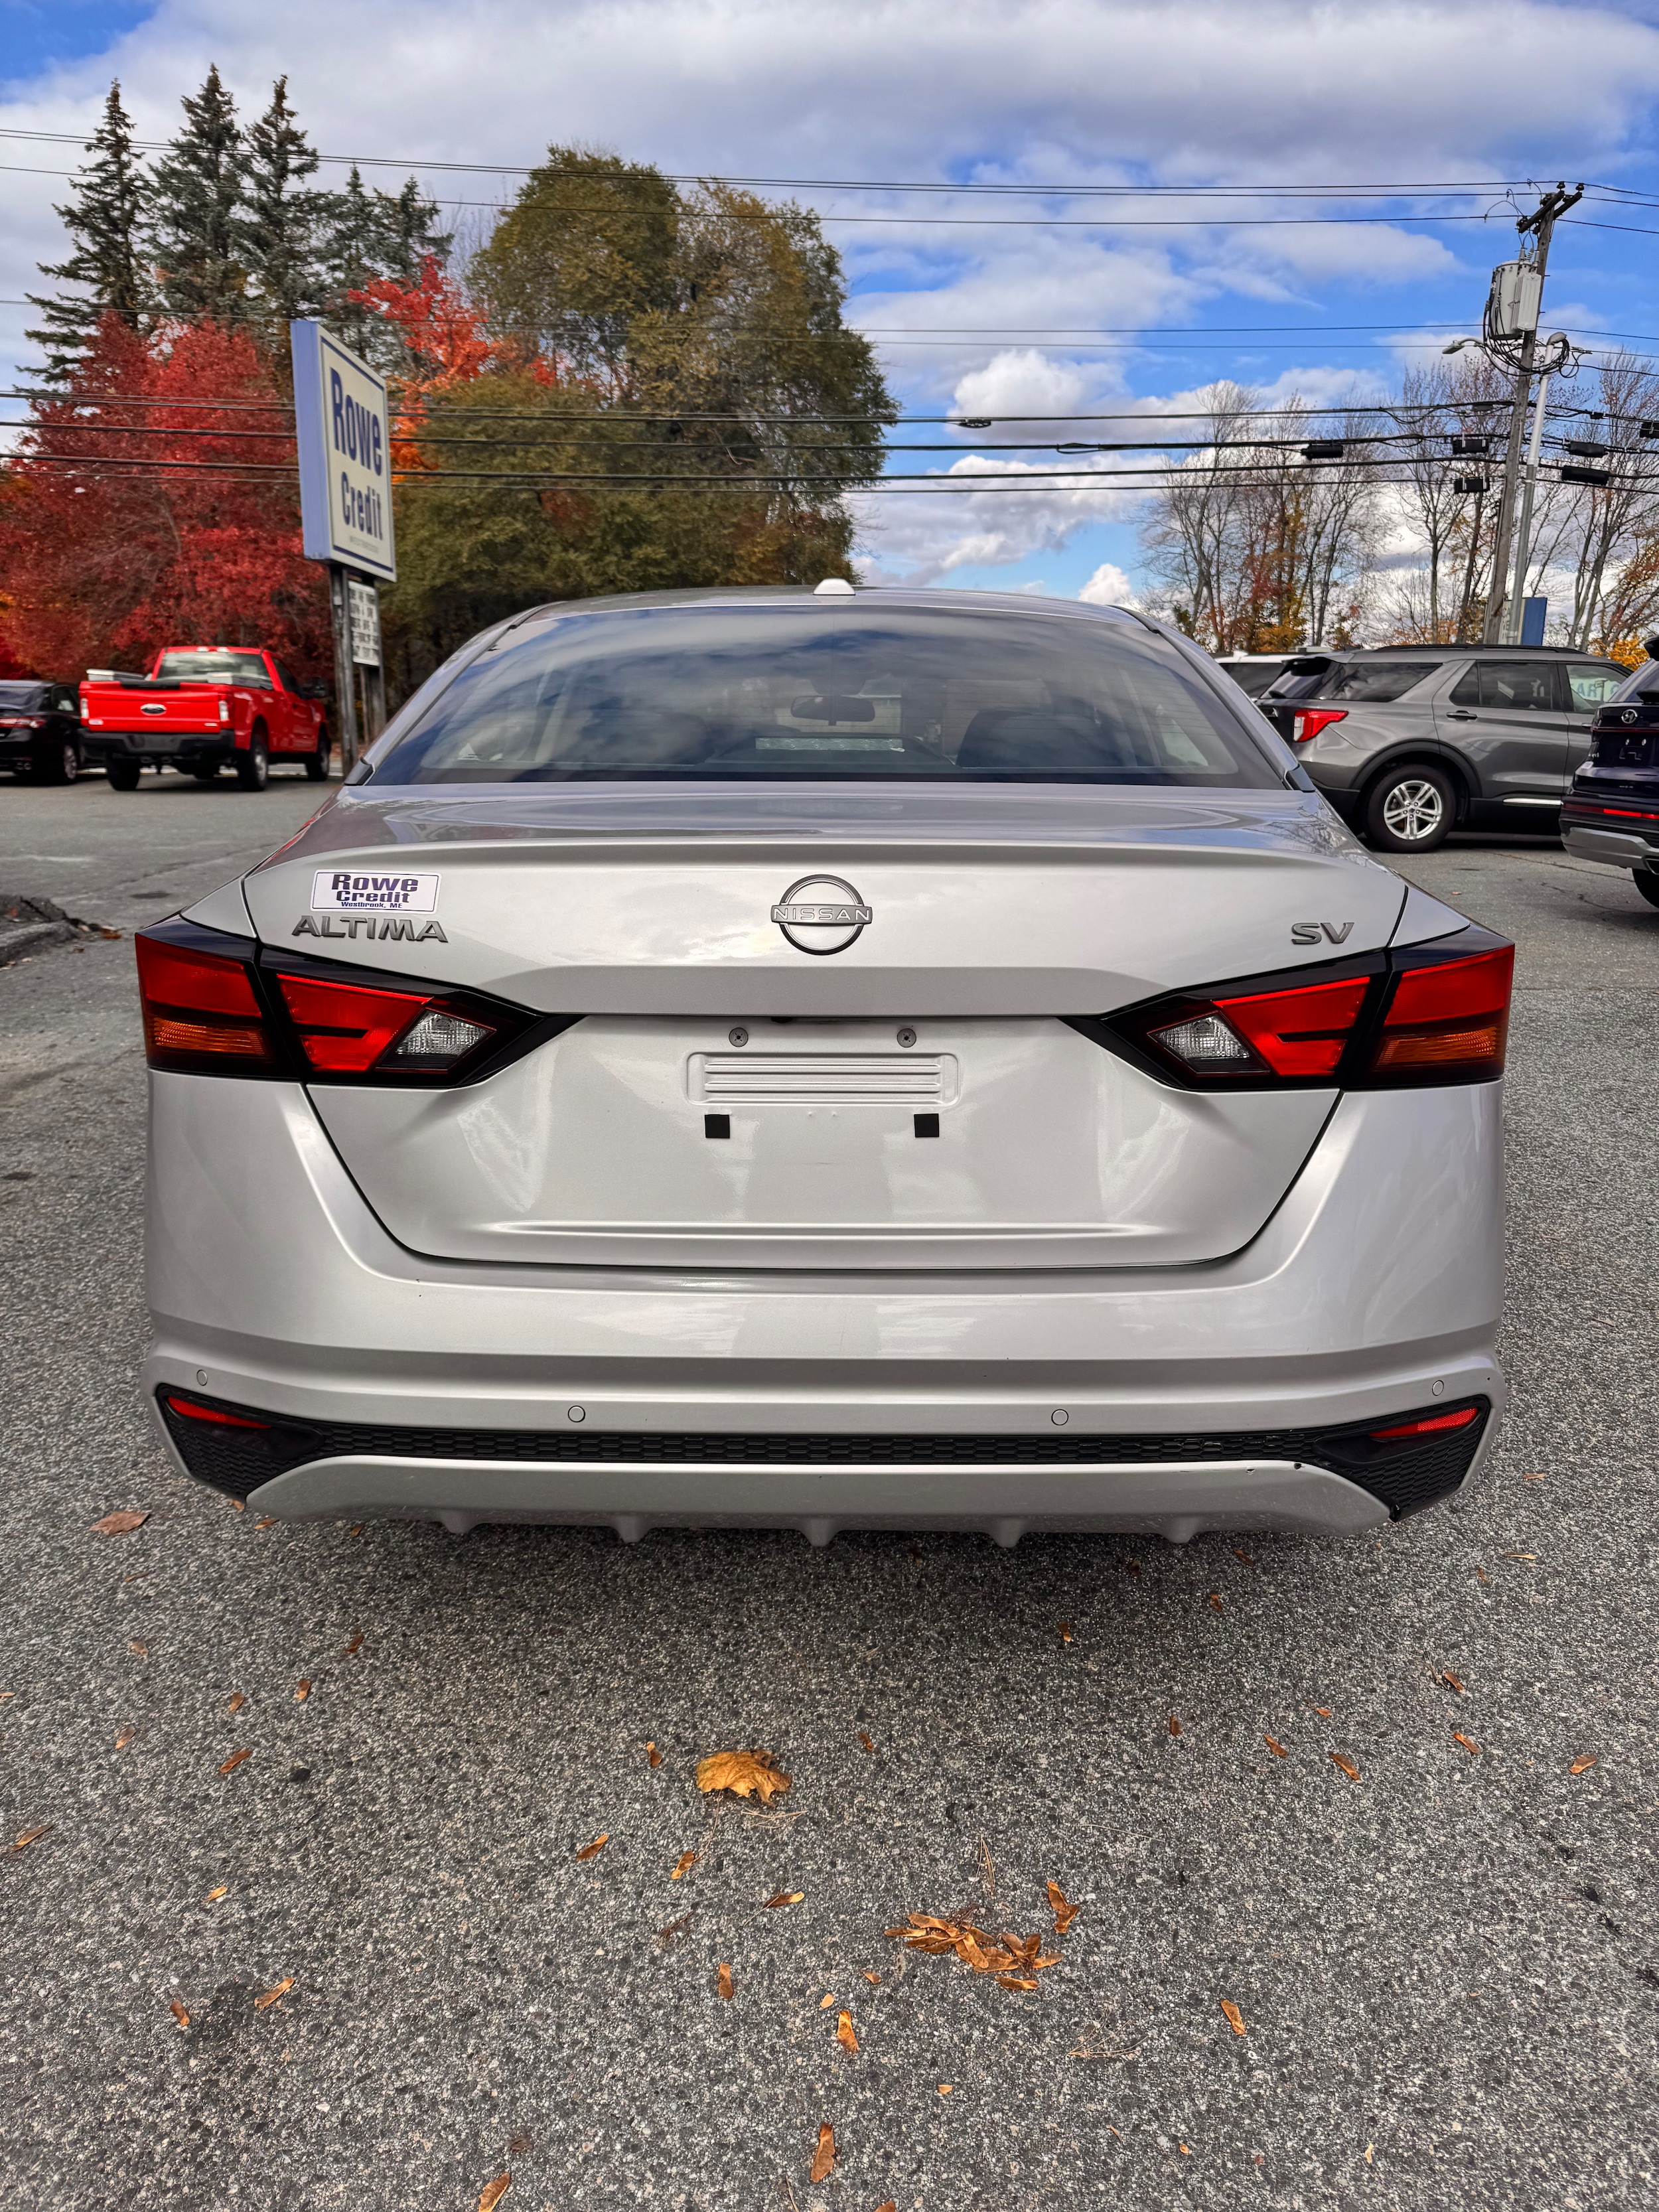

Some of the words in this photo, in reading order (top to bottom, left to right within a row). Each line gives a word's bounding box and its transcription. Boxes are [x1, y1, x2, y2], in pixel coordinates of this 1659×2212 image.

[330, 366, 382, 477] Rowe
[340, 471, 383, 541] Credit
[332, 874, 419, 892] Rowe
[336, 891, 411, 903] Credit
[774, 907, 870, 921] NISSAN
[291, 915, 449, 943] ALTIMA
[1291, 922, 1354, 945] SV
